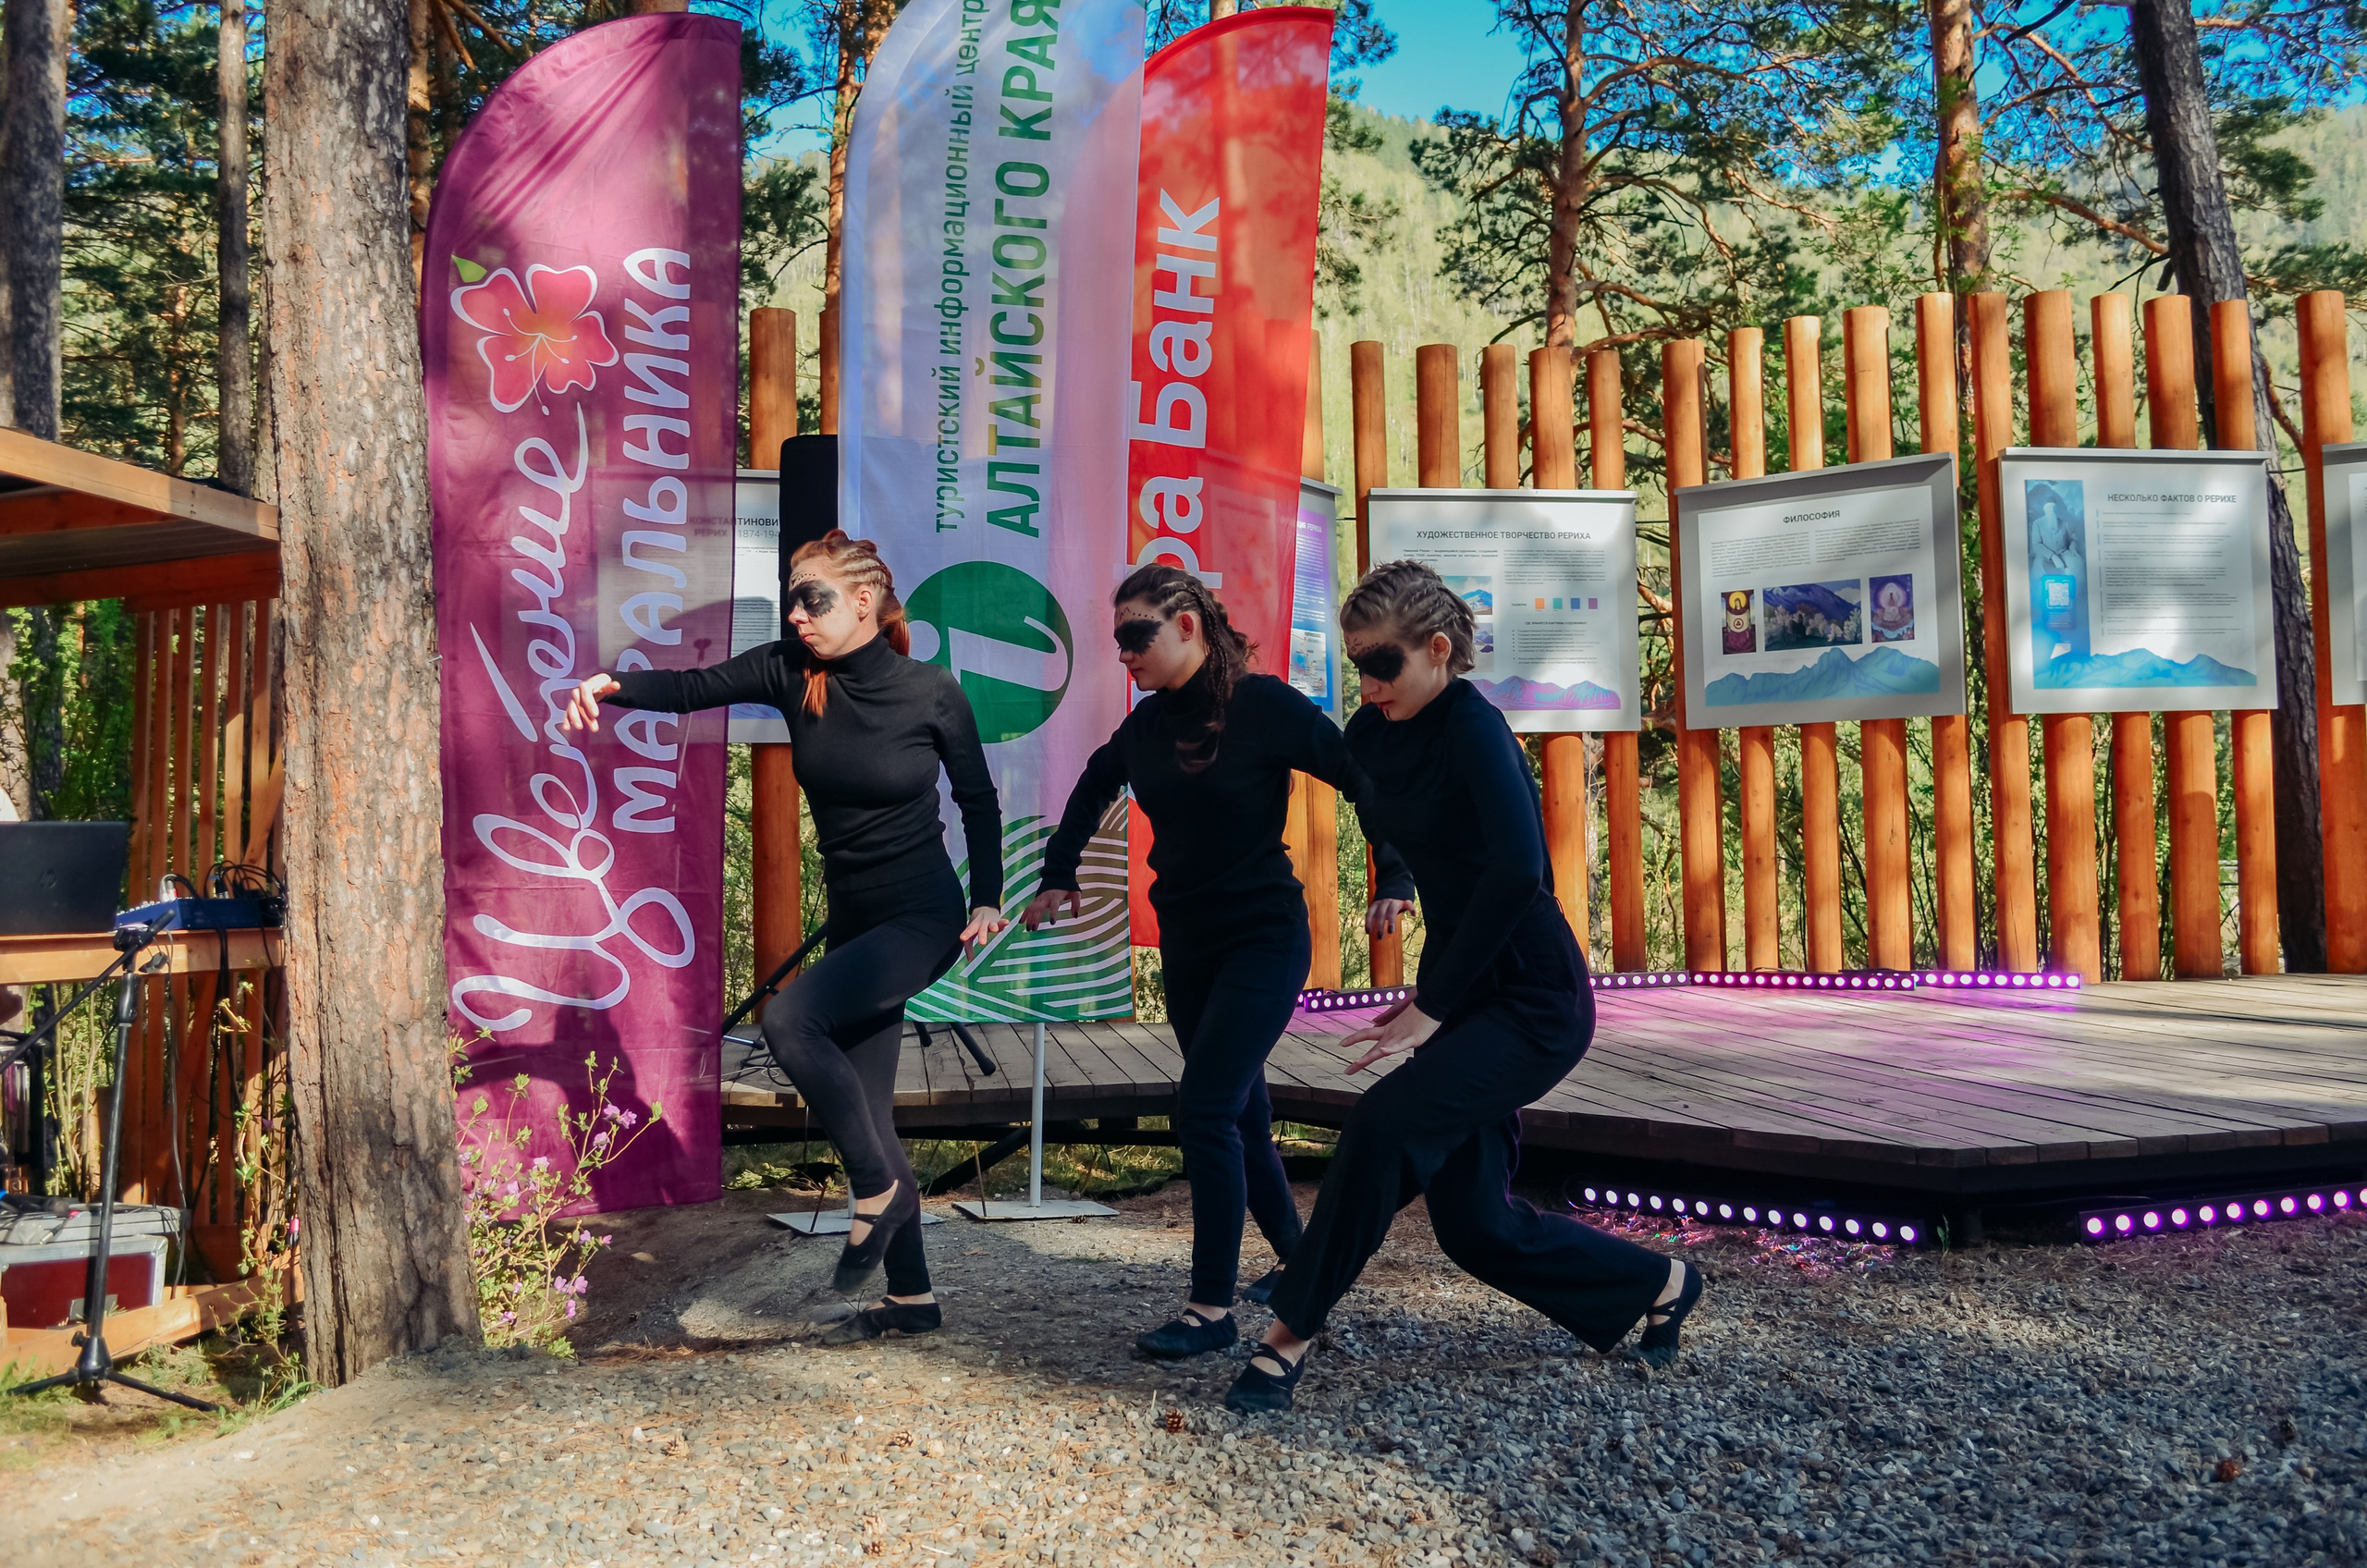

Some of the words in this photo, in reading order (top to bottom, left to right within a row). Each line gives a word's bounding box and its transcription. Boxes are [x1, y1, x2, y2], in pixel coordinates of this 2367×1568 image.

[955, 0, 990, 77] центр
[999, 0, 1061, 141] КРАЯ
[934, 85, 975, 356] информационный
[975, 161, 1050, 539] АЛТАЙСКОГО
[1128, 188, 1220, 449] Банк
[931, 365, 965, 533] туристский
[689, 516, 779, 527] КОНСТАНТИНОВИ
[738, 529, 779, 540] 1874-194
[1417, 530, 1499, 540] ХУДОЖЕСТВЕННОЕ
[1501, 531, 1556, 540] ТВОРЧЕСТВО
[1557, 532, 1591, 540] РЕРИХА
[1783, 509, 1841, 524] ФИЛОСОФИЯ
[2107, 493, 2159, 502] НЕСКОЛЬКО
[2160, 494, 2195, 503] ФАКТОВ
[2204, 495, 2238, 504] РЕРИХЕ
